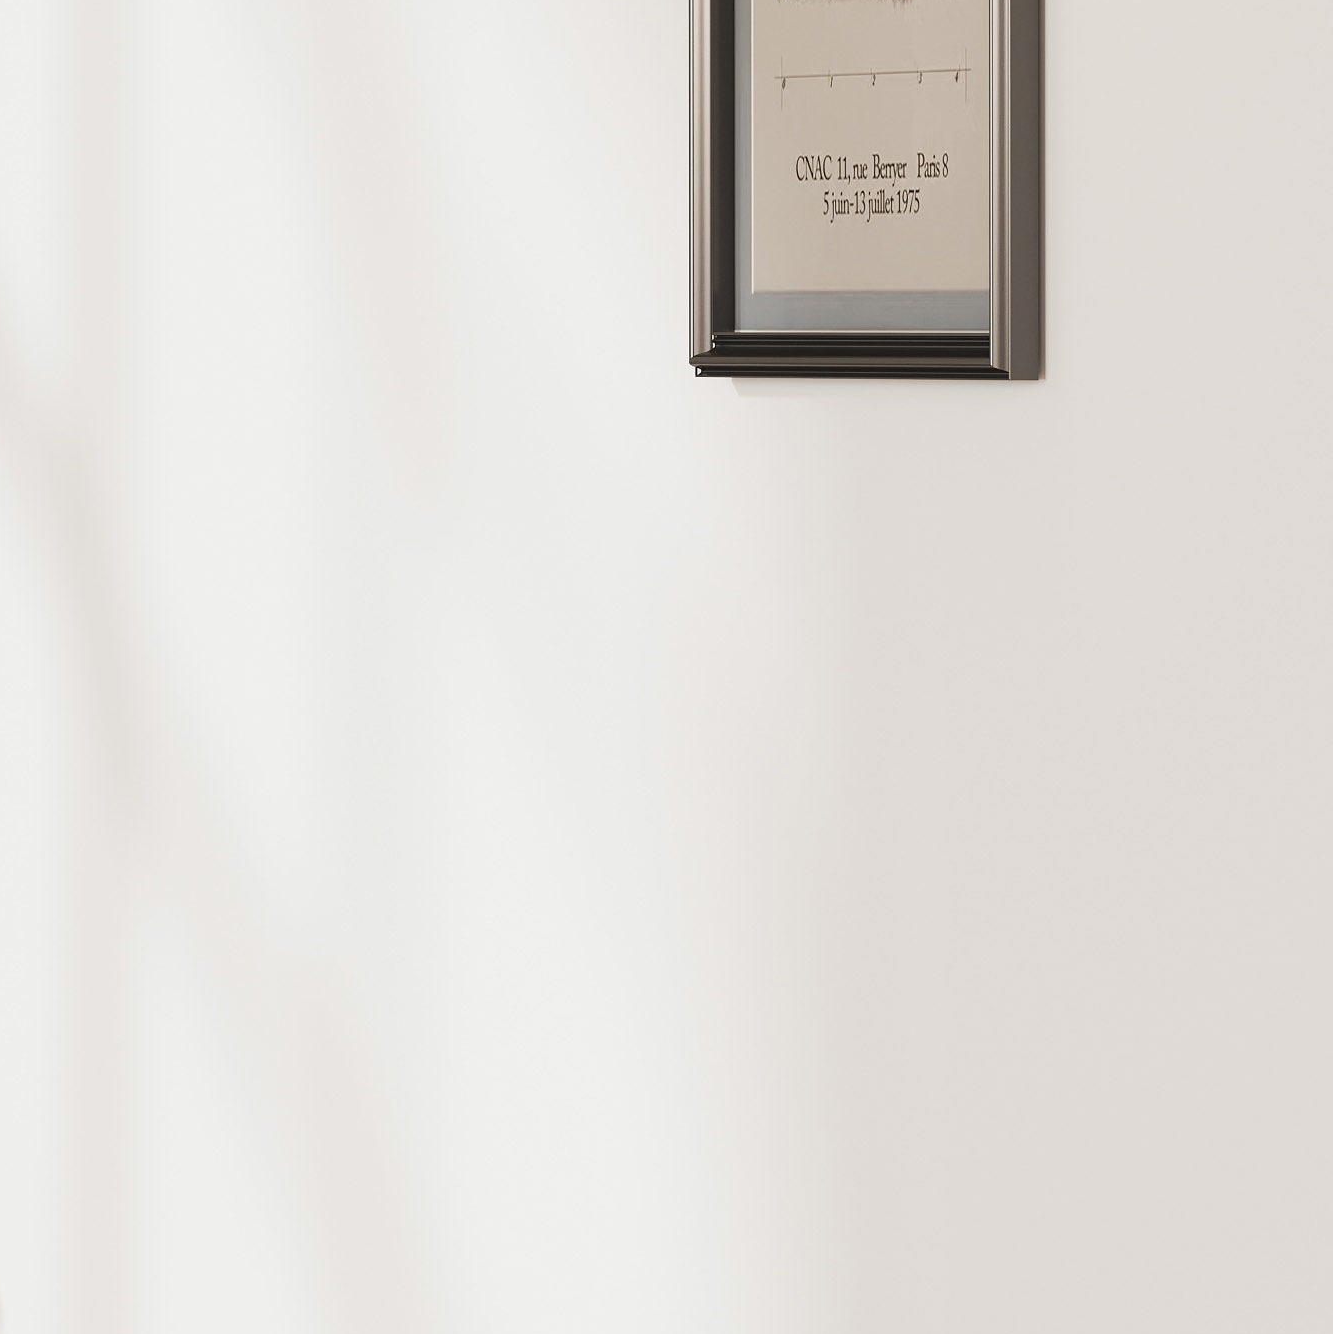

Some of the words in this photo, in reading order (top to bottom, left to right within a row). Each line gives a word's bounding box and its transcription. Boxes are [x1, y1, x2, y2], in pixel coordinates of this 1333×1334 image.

[795, 154, 833, 181] CNAC
[837, 156, 851, 184] 11,
[852, 162, 868, 180] rue
[872, 154, 907, 187] Berryer
[916, 152, 940, 178] Paris
[942, 153, 949, 178] 8
[823, 190, 829, 215] 5
[830, 190, 866, 223] juin-13
[866, 189, 895, 223] juillet
[896, 189, 920, 214] 1975
